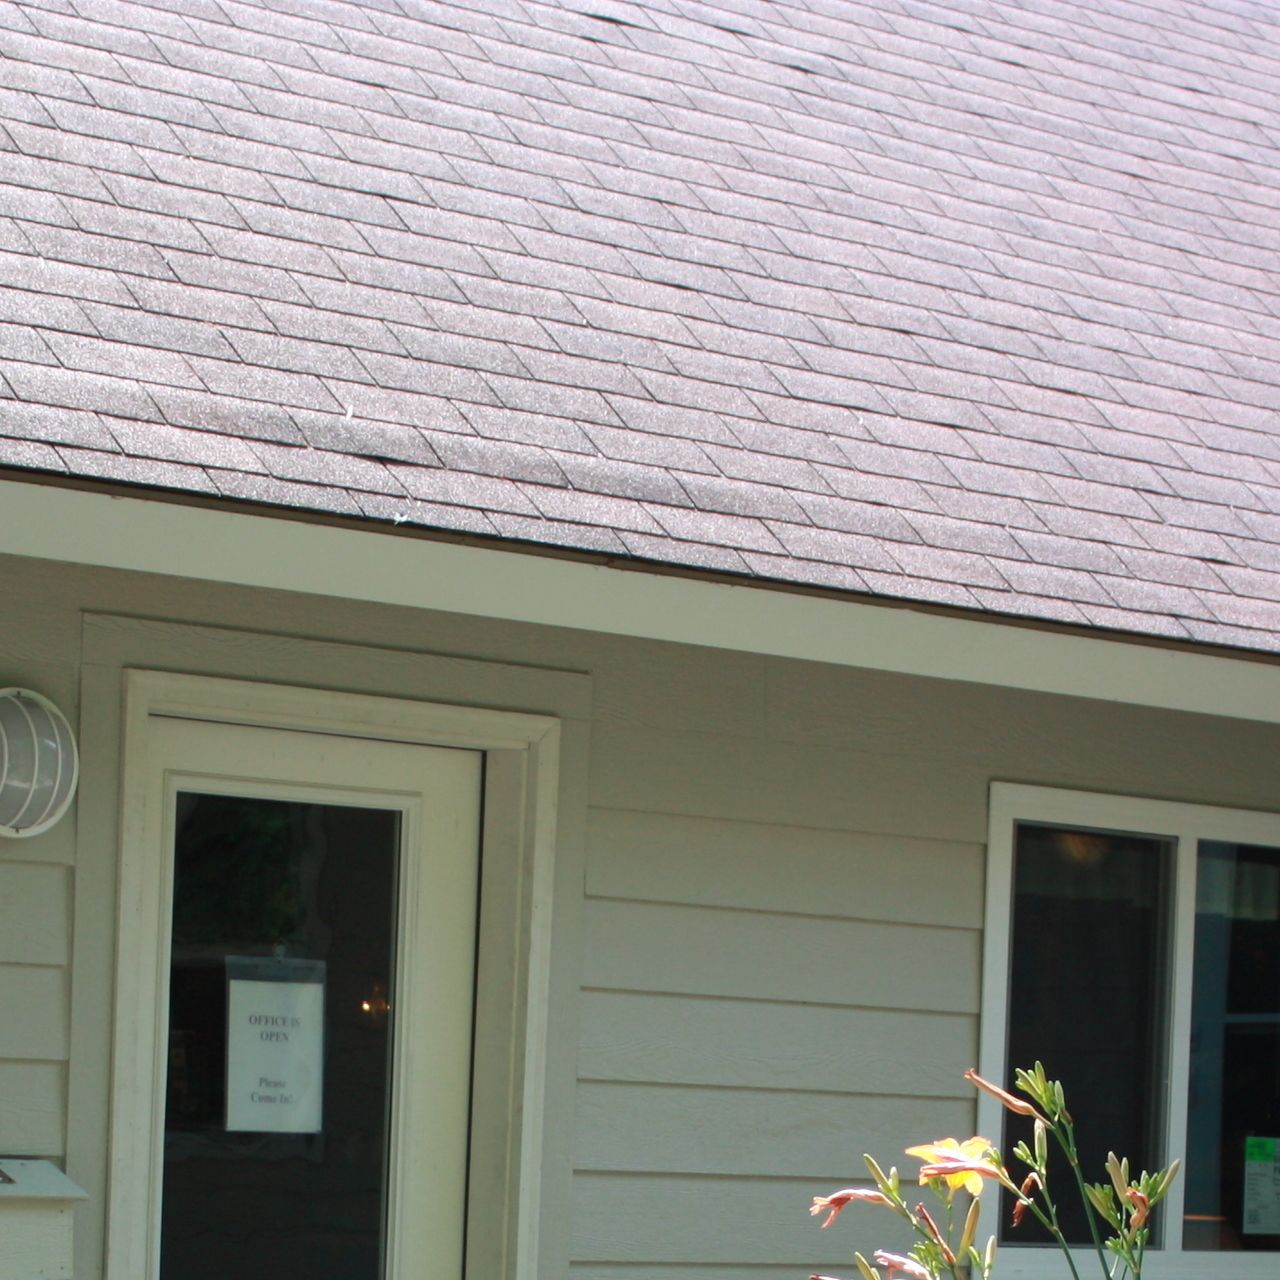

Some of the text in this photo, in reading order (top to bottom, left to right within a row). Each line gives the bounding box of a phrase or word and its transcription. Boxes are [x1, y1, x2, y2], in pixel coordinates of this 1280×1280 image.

[248, 1015, 288, 1027] OFFICE
[260, 1030, 289, 1042] OPEN
[259, 1077, 286, 1088] Please
